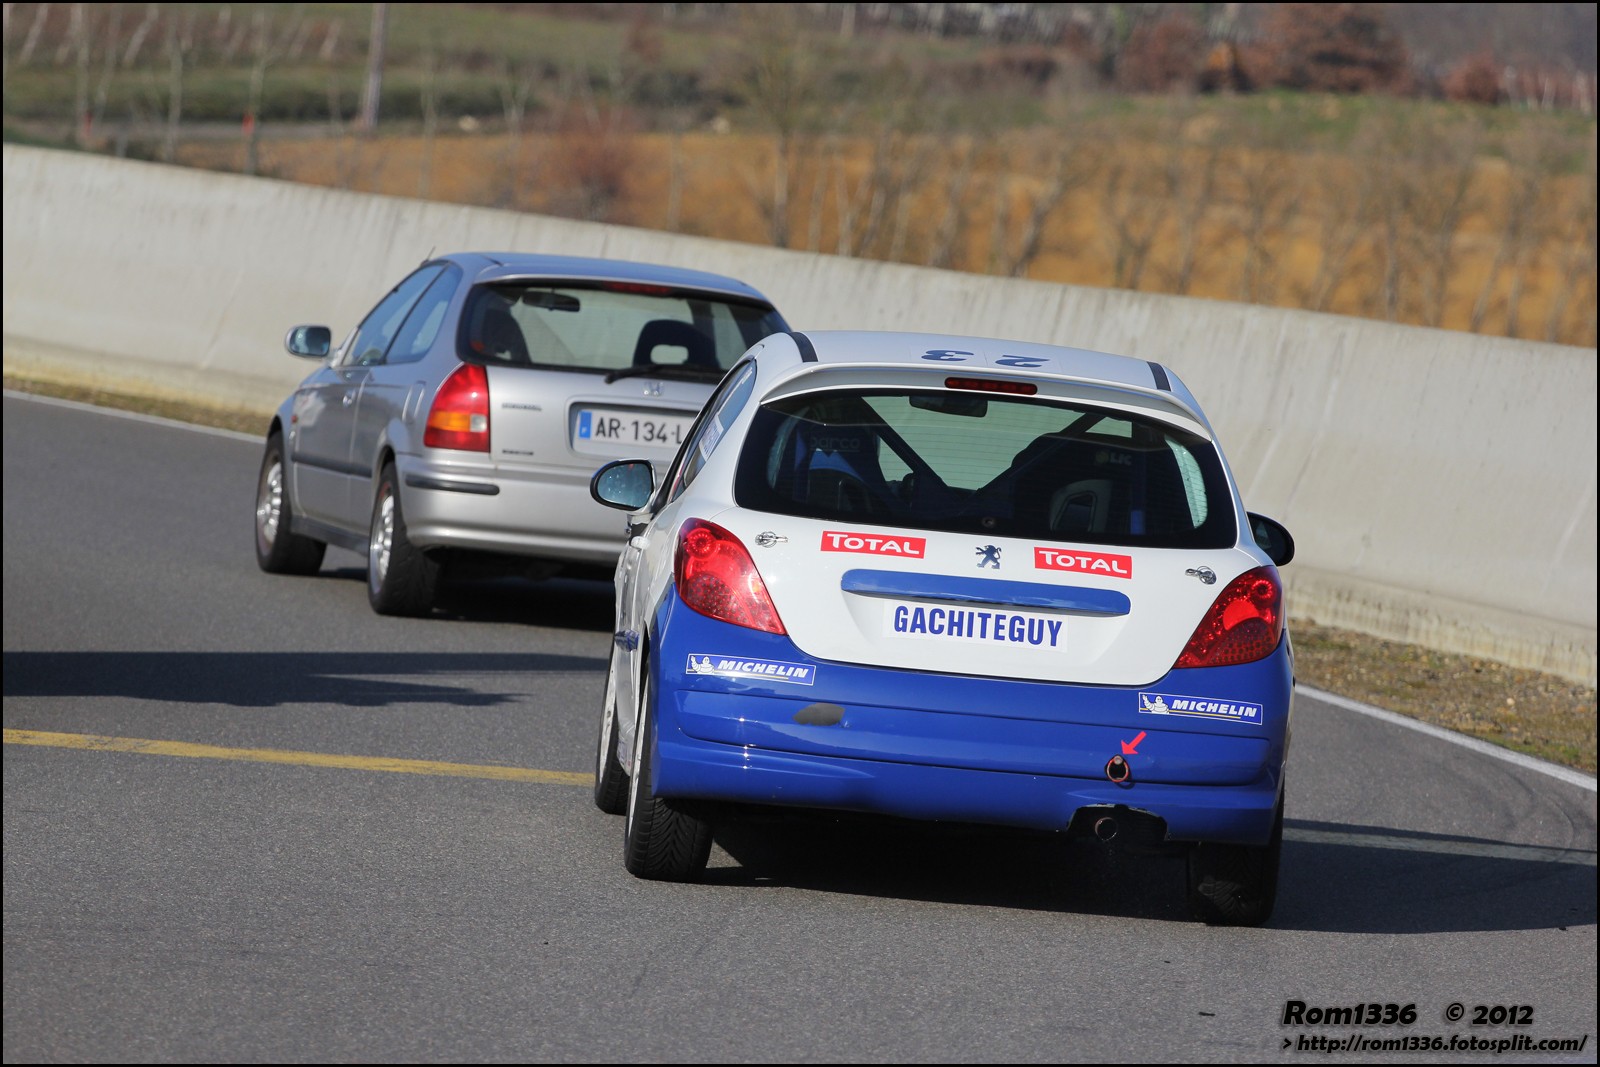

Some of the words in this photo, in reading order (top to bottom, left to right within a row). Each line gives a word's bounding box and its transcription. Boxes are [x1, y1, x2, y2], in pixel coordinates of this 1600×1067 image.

[893, 606, 1063, 647] GACHITEGUY
[717, 659, 809, 678] MICHELIN
[1171, 699, 1258, 718] MICHELIN
